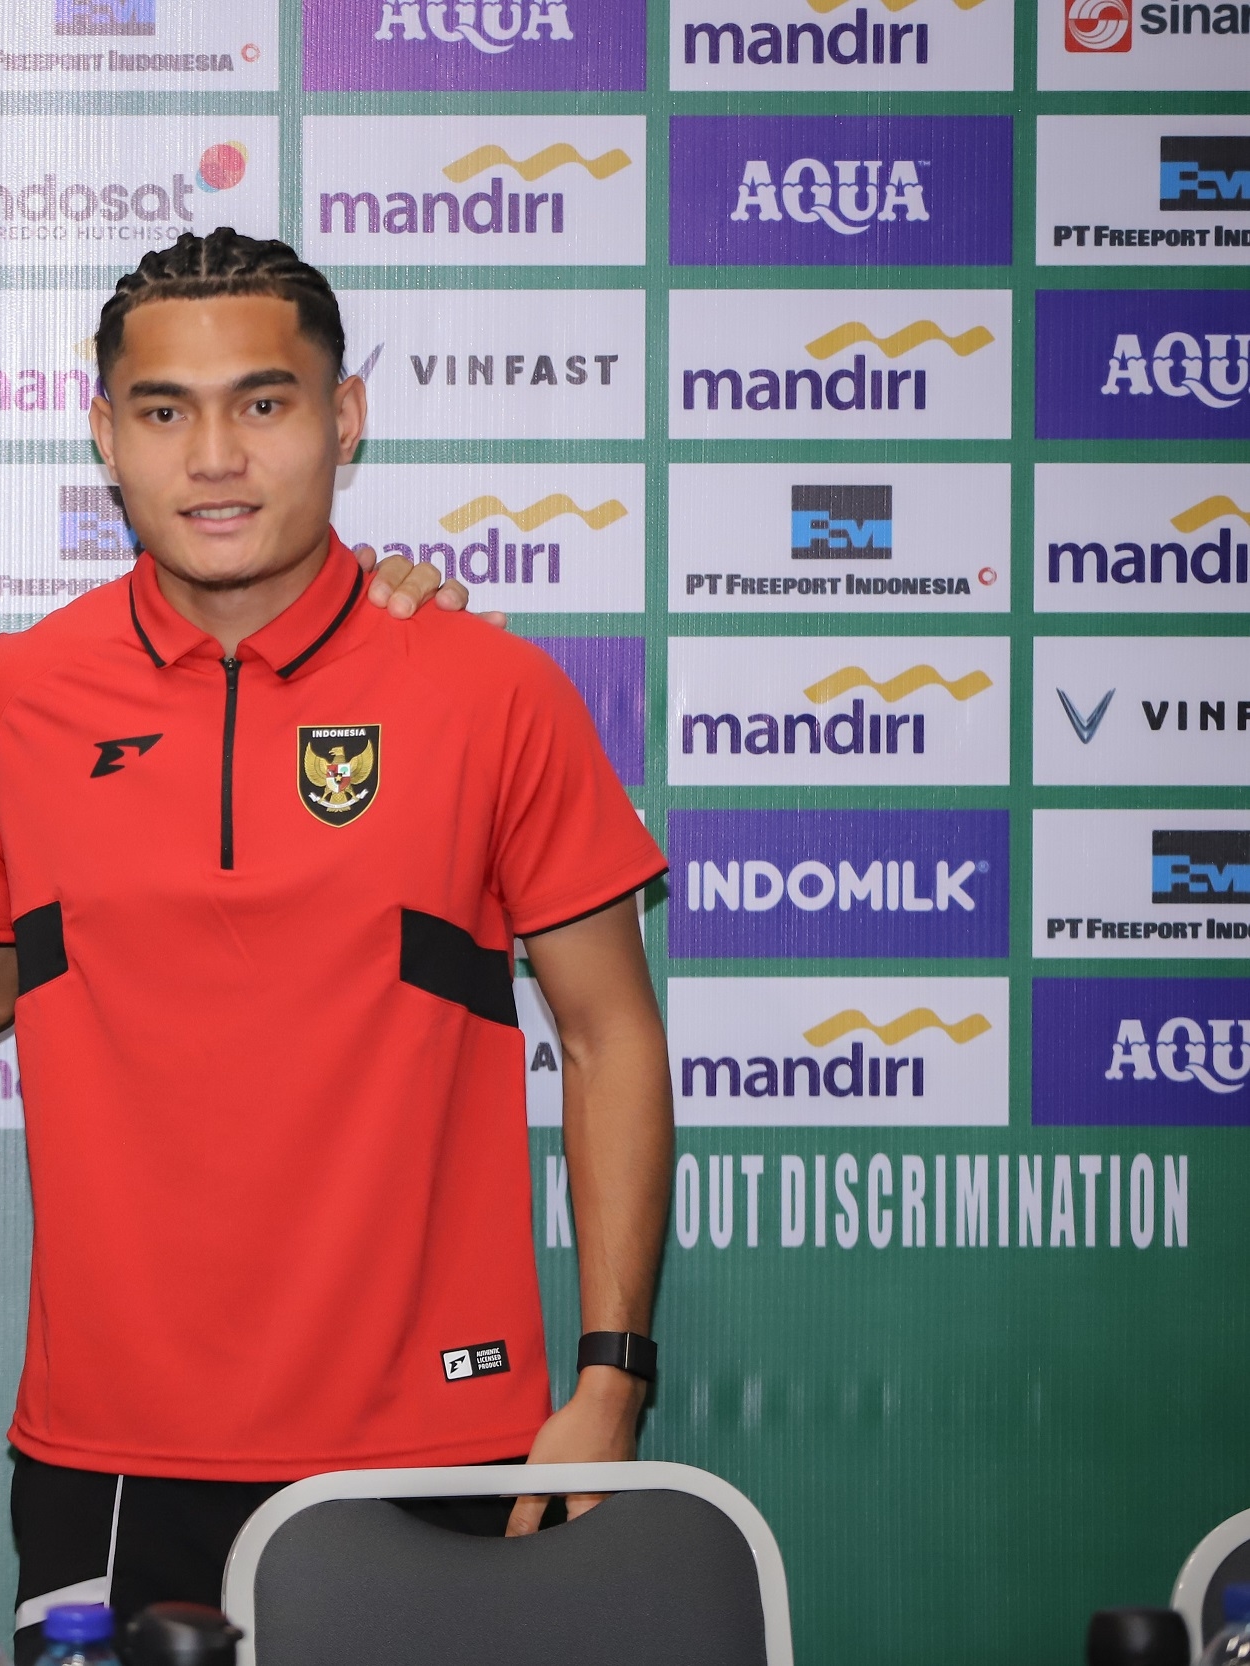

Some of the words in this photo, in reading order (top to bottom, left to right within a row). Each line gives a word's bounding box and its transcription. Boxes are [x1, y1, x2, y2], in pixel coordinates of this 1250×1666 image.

[684, 8, 928, 64] mandiri
[108, 49, 234, 72] INDONESIA
[320, 177, 564, 234] mandiri
[731, 158, 931, 235] AQUA
[1053, 225, 1090, 247] PT
[1094, 225, 1210, 247] FREEPORT
[410, 354, 619, 386] VINFAST
[682, 354, 926, 411] mandiri
[686, 574, 722, 595] PT
[726, 574, 841, 595] FREEPORT
[846, 573, 971, 595] INDONESIA
[312, 728, 366, 738] INDONESIA
[682, 699, 925, 755] mandiri
[688, 860, 976, 911] INDOMILK
[1047, 919, 1083, 939] PT
[1087, 919, 1202, 940] FREEPORT
[681, 1041, 924, 1097] mandiri
[675, 1153, 764, 1249] OUT
[781, 1153, 1188, 1249] DISCRIMINATION
[476, 1347, 500, 1357] AUTHENTIC
[477, 1354, 502, 1364] LICENSED
[478, 1361, 502, 1371] PRODUCT
